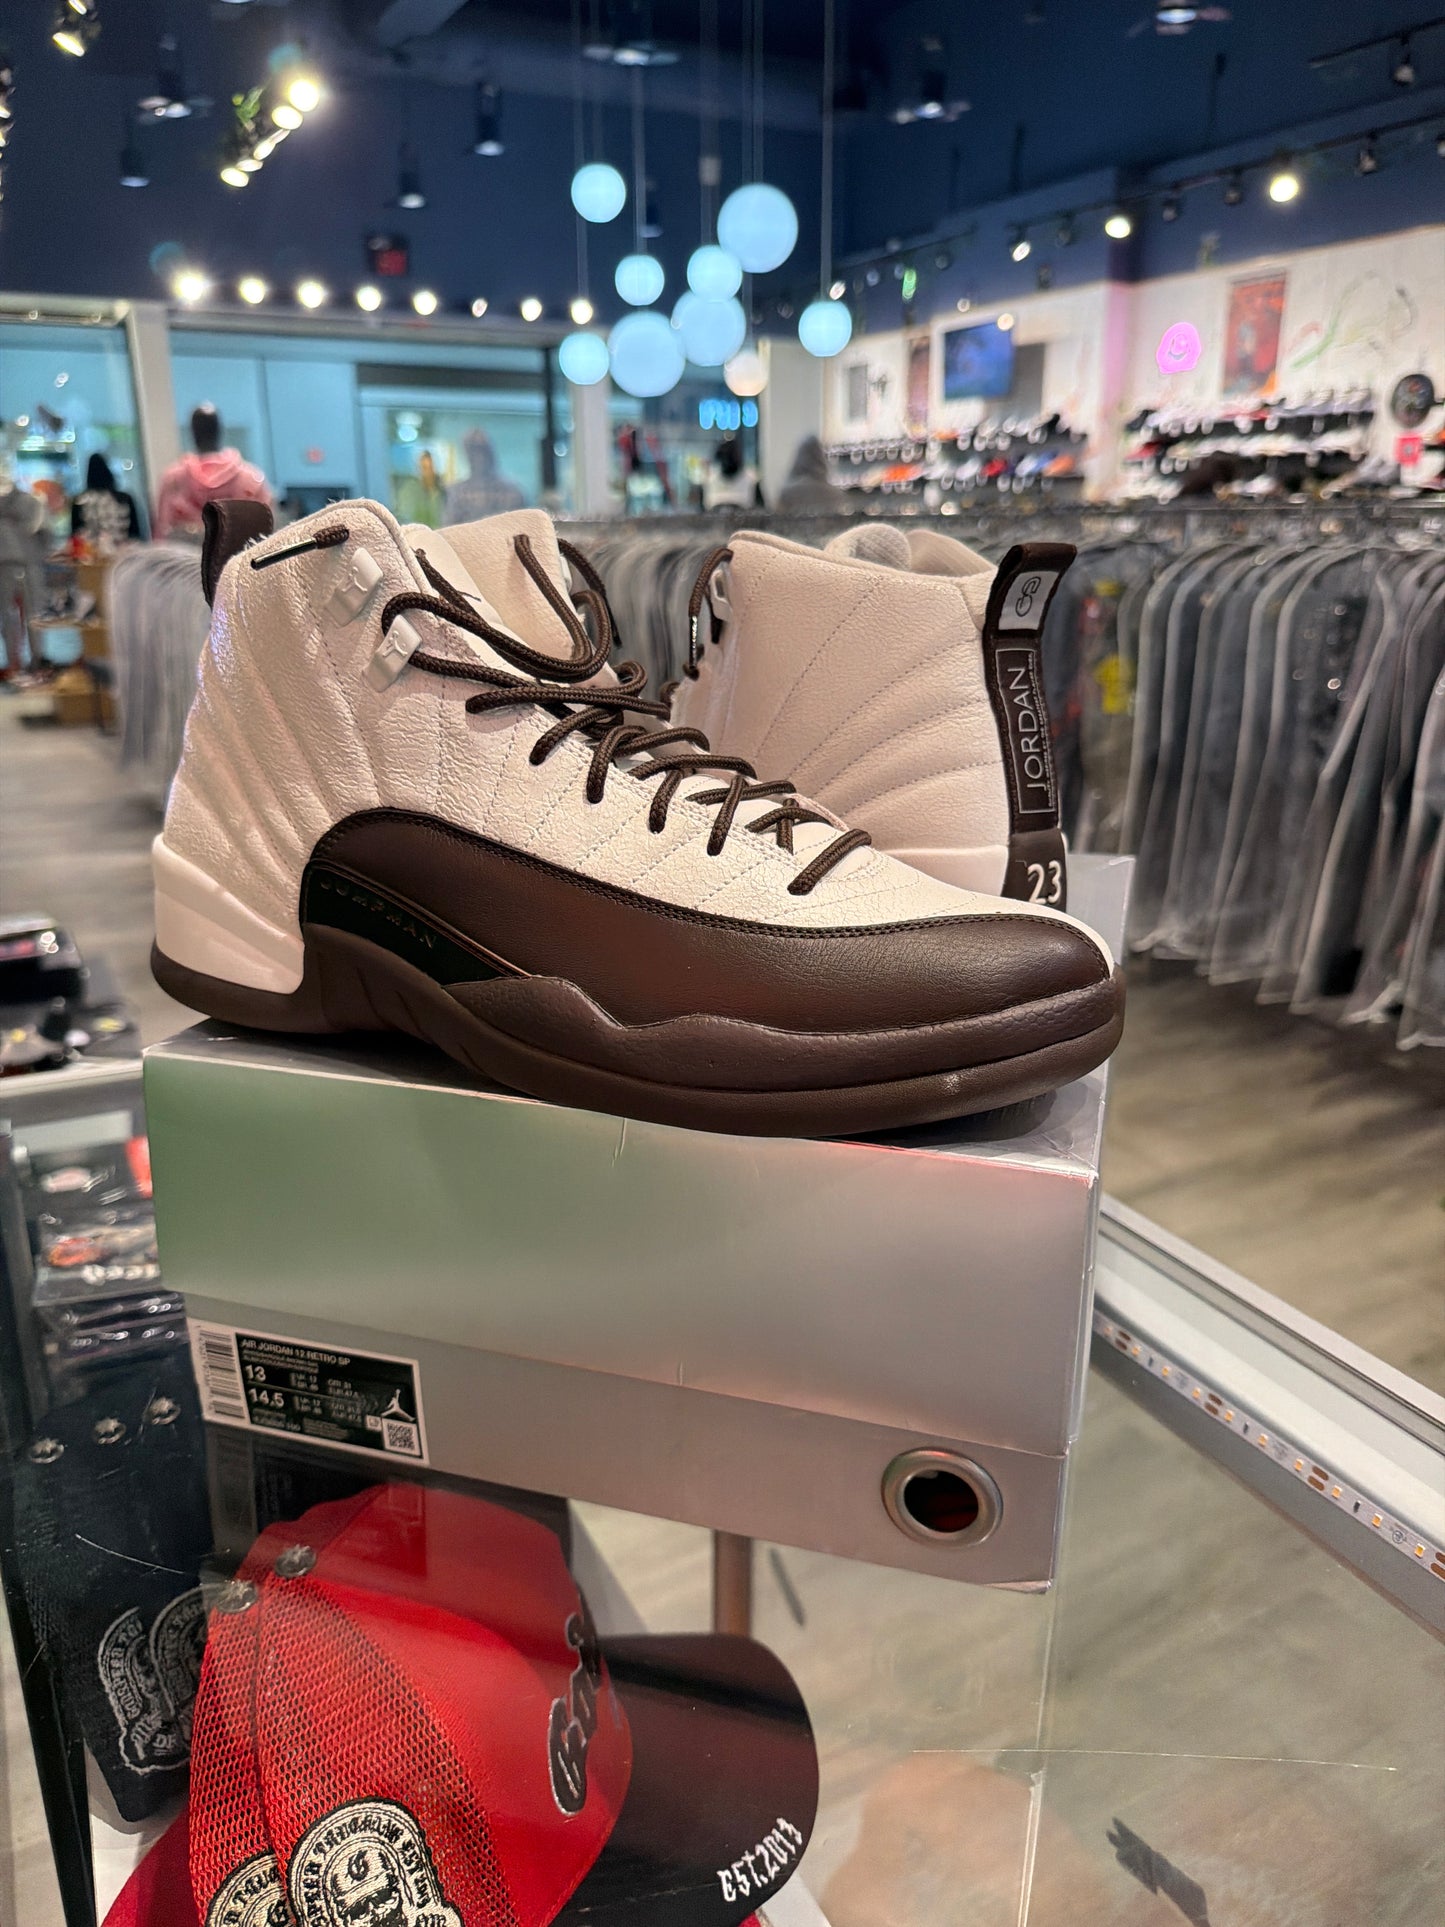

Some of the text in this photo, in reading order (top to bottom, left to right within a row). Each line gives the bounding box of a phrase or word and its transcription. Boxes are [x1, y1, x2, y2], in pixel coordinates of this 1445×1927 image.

[1007, 667, 1047, 792] JORDAN
[1029, 861, 1061, 904] 23
[241, 1339, 257, 1349] AIR
[258, 1342, 293, 1356] JORDAN
[295, 1349, 305, 1358] 12
[307, 1352, 336, 1364] RETRO
[245, 1364, 266, 1383] 13
[248, 1388, 284, 1408] 14.5
